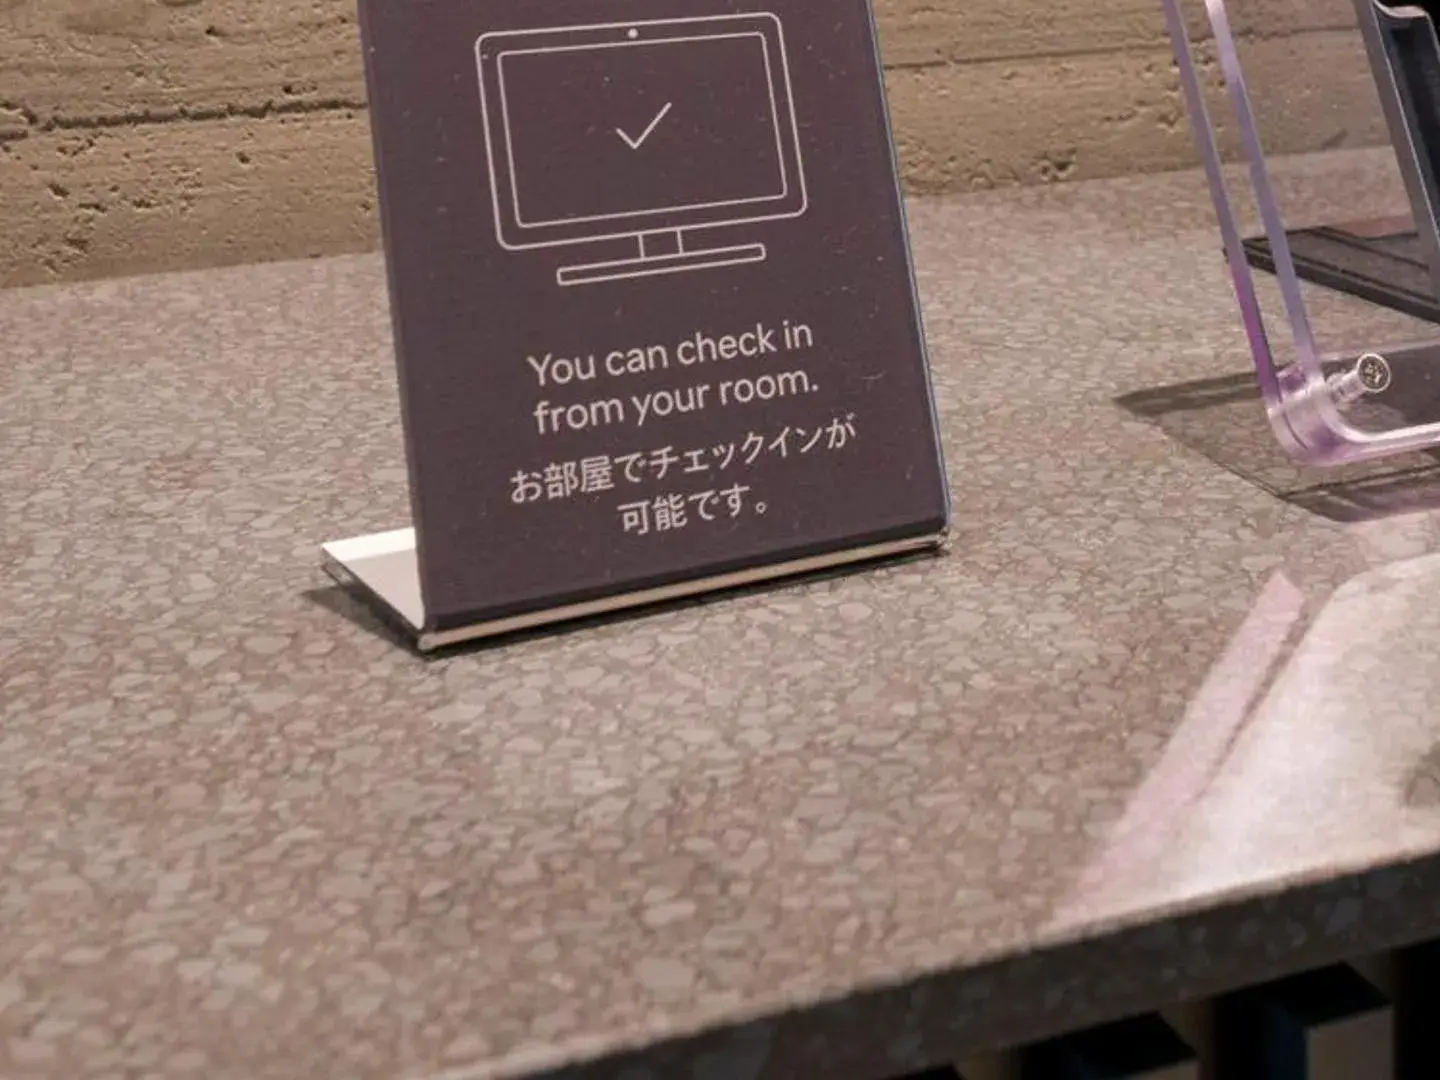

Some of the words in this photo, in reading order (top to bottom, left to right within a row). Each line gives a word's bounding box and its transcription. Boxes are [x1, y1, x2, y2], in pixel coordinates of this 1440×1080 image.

[527, 354, 596, 387] You
[605, 344, 669, 377] can
[677, 323, 777, 368] check
[782, 320, 814, 351] in
[533, 398, 625, 435] from
[632, 383, 710, 426] your
[719, 369, 820, 406] room.
[510, 412, 857, 506] お部屋でチェックインが
[617, 482, 768, 537] 可能です。
